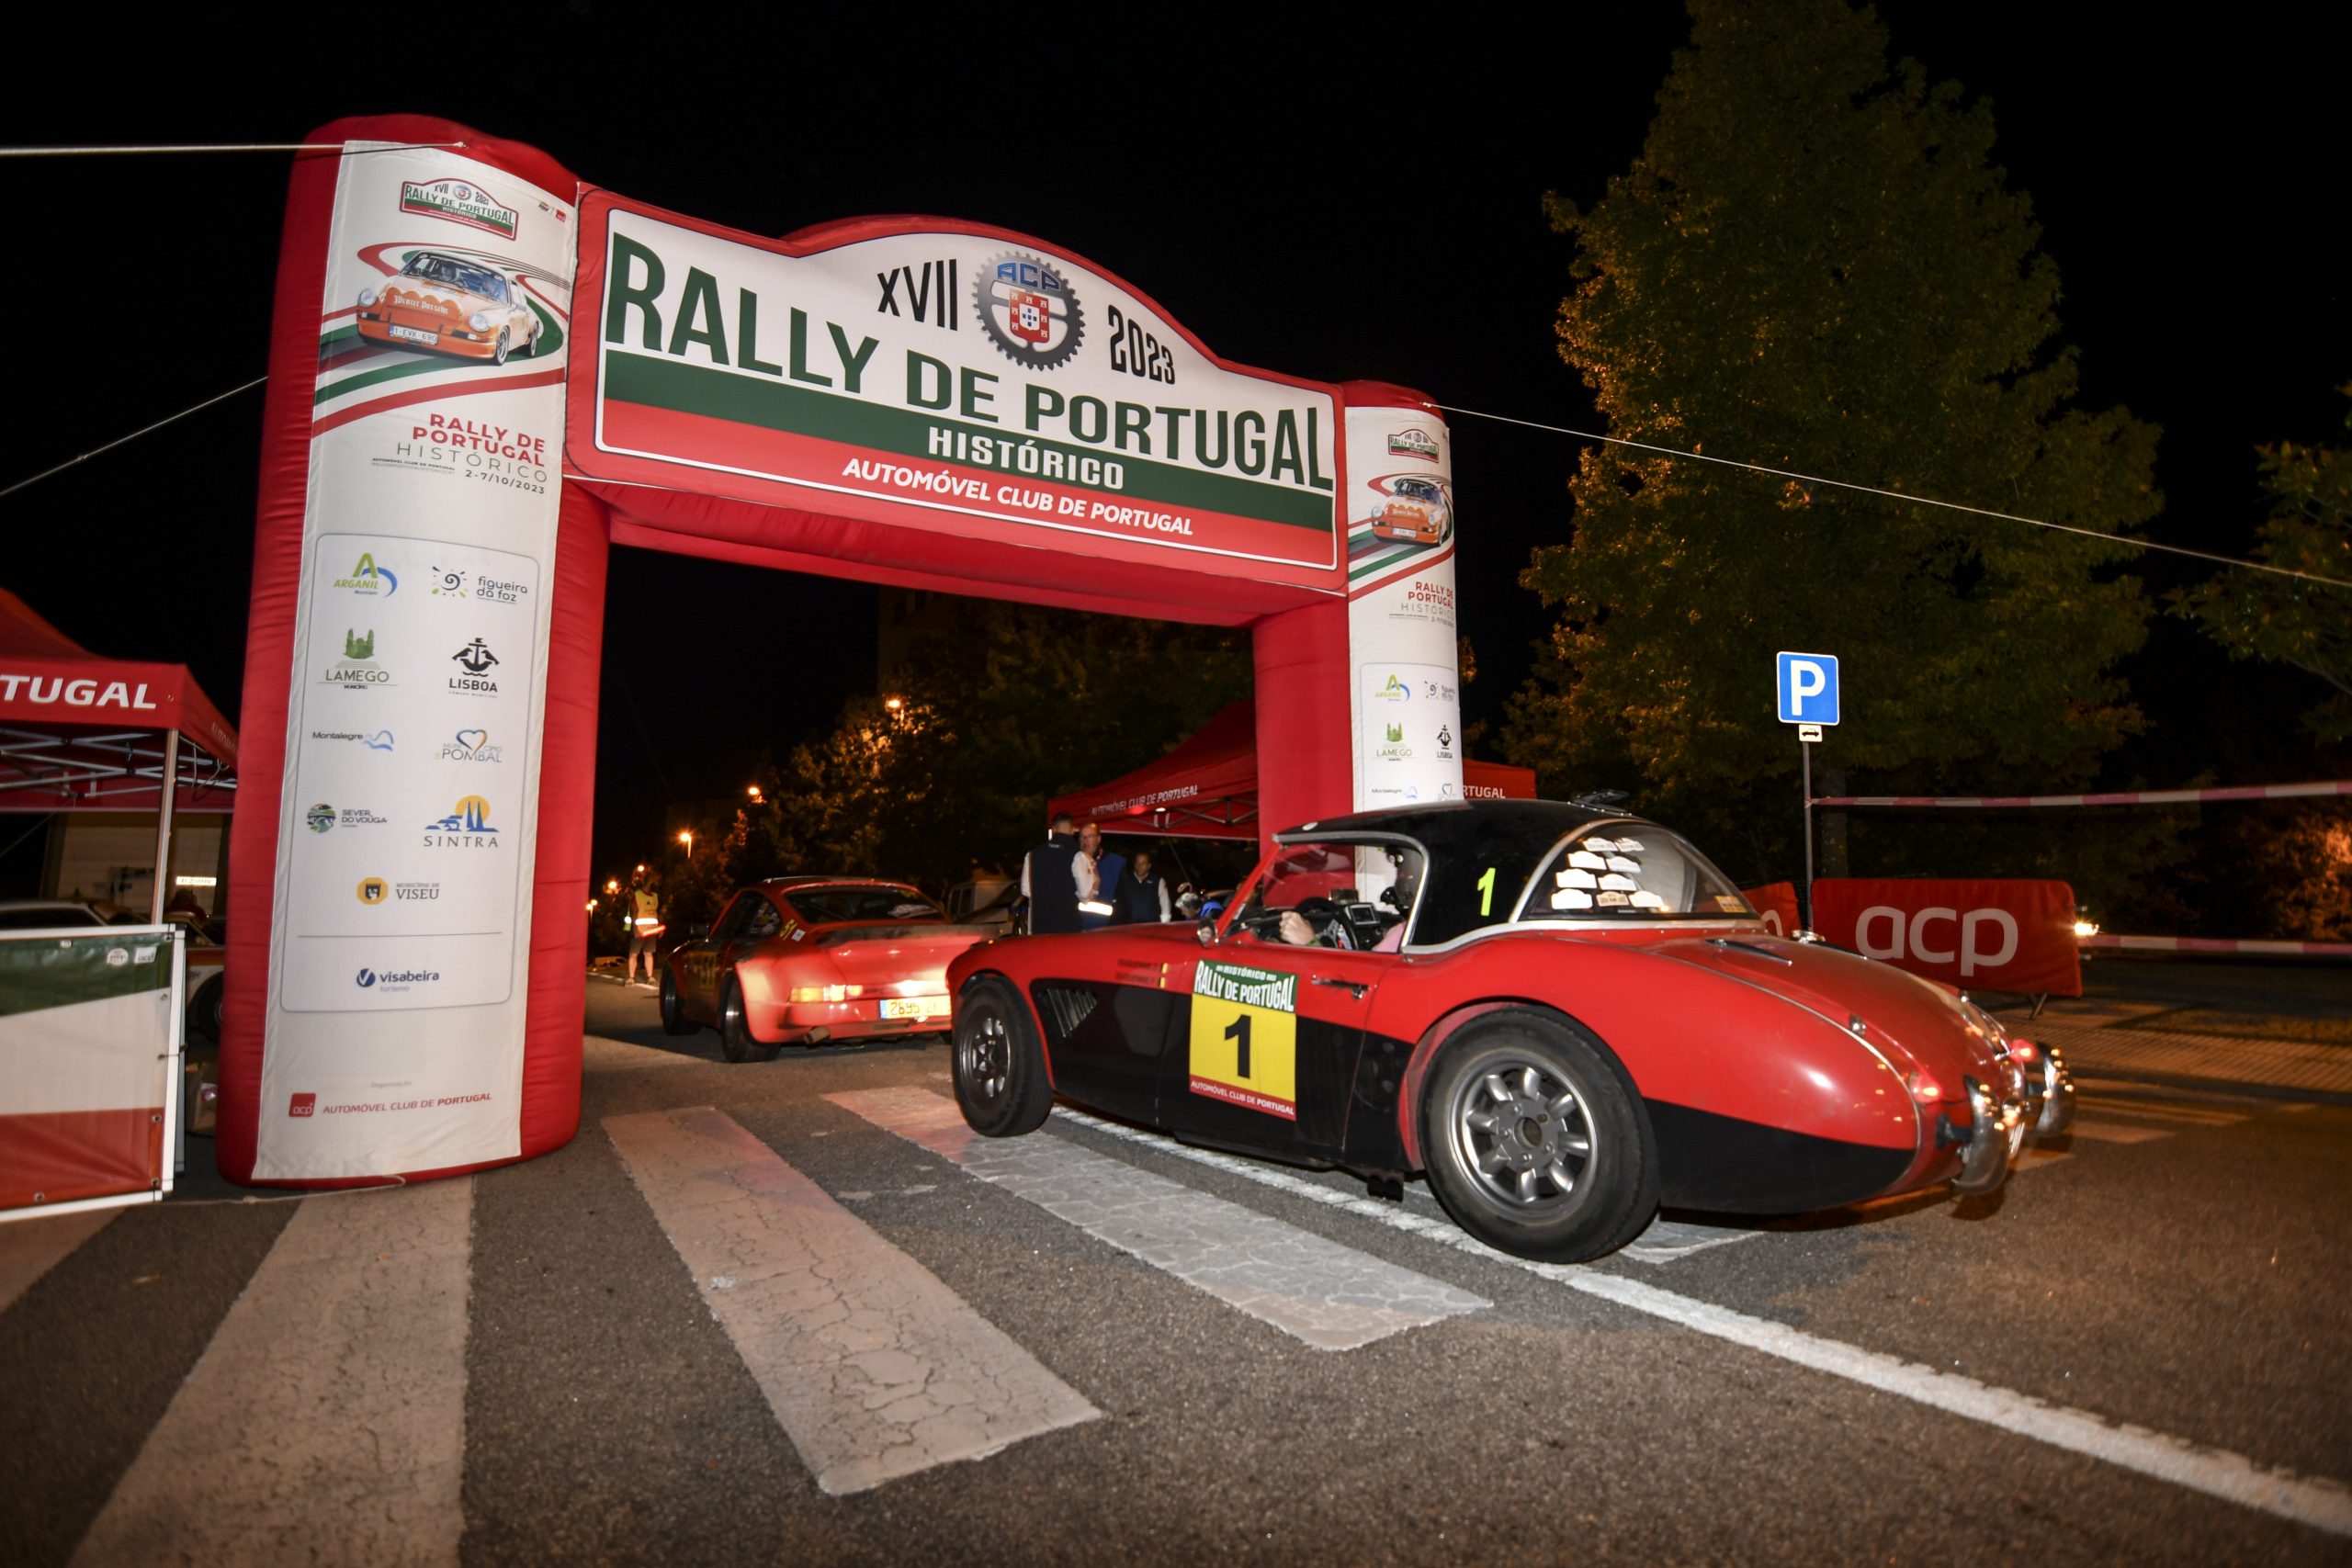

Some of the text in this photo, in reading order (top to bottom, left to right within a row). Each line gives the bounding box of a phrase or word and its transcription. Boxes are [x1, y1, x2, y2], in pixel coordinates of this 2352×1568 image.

[405, 185, 514, 225] RALLY DE PORTUGAL
[878, 258, 1175, 386] XVII ACP 2023
[605, 231, 1334, 492] RALLY DE PORTUGAL
[430, 413, 545, 453] RALLY DE
[413, 426, 545, 467] PORTUGAL
[929, 426, 1124, 491] HISTÓRICO
[397, 443, 548, 482] HISTÓRICO
[465, 469, 545, 494] 2-7/10/2023
[842, 458, 1193, 536] AUTOMÓVEL CLUB DE PORTUGAL
[334, 579, 379, 589] ARGANIL
[477, 588, 493, 597] da
[498, 590, 516, 602] foz
[478, 576, 527, 593] figueira
[1416, 581, 1444, 594] RALLY
[325, 670, 390, 682] LAMEGO
[449, 677, 498, 693] LISBOA
[1791, 659, 1826, 716] P
[312, 731, 364, 742] Montalegre
[442, 749, 502, 763] POMBAL
[1376, 749, 1412, 757] LAMEGO
[1128, 795, 1146, 808] CLUB
[1147, 794, 1157, 805] DE
[1158, 784, 1198, 802] PORTUGAL
[424, 835, 499, 848] SINTRA
[396, 888, 439, 900] VISEU
[1477, 867, 1496, 917] 1
[1855, 905, 2018, 977] acp
[379, 970, 439, 983] visabeira
[1223, 965, 1266, 980] HISTÓRICO
[1194, 959, 1295, 1012] RALLY DE PORTUGAL
[1224, 1013, 1251, 1079] 1
[322, 1103, 387, 1113] AUTOMÓVEL
[390, 1101, 417, 1110] CLUB
[421, 1100, 434, 1108] DE
[437, 1093, 492, 1106] PORTUGAL
[1191, 1080, 1295, 1115] AUTOMÓVEL CLUB DE PORTUGAL
